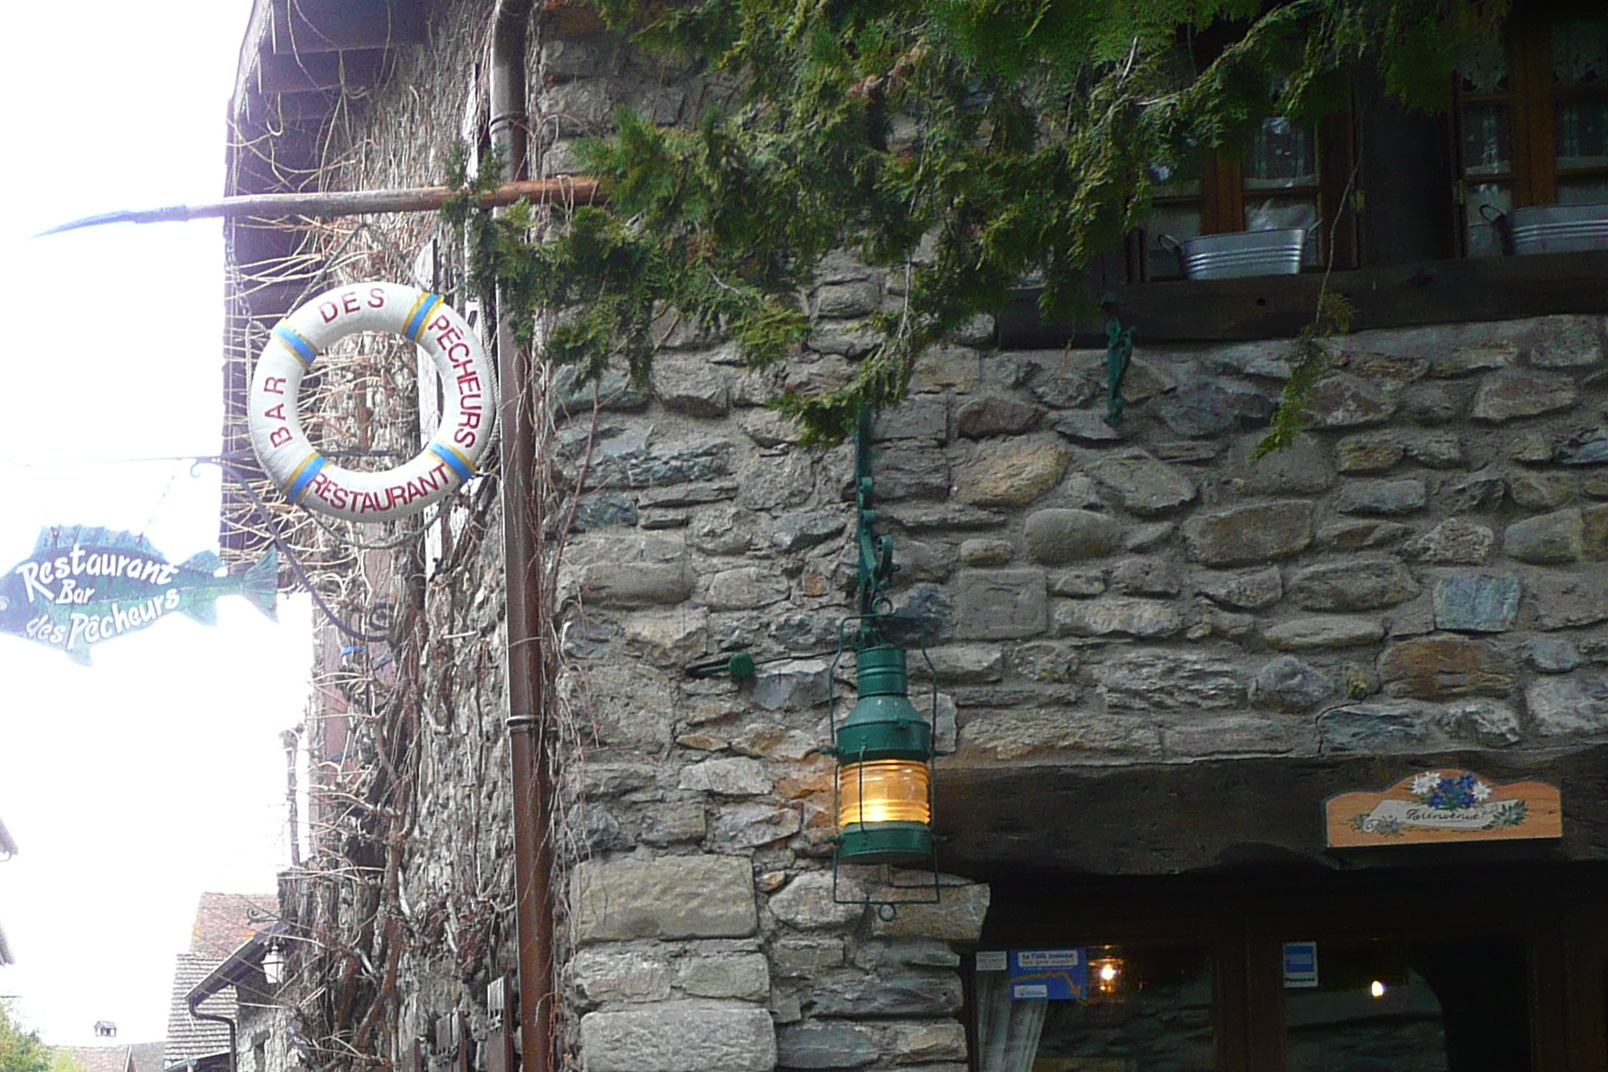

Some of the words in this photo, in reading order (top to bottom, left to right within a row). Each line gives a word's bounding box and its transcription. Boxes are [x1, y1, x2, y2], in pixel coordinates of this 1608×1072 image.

[264, 376, 293, 448] BAR
[319, 288, 385, 324] DES
[307, 463, 451, 514] RESTAURANT
[16, 544, 180, 602] Restaurant
[55, 580, 95, 605] Bar
[26, 614, 65, 644] des
[66, 588, 181, 650] Pêcheurs
